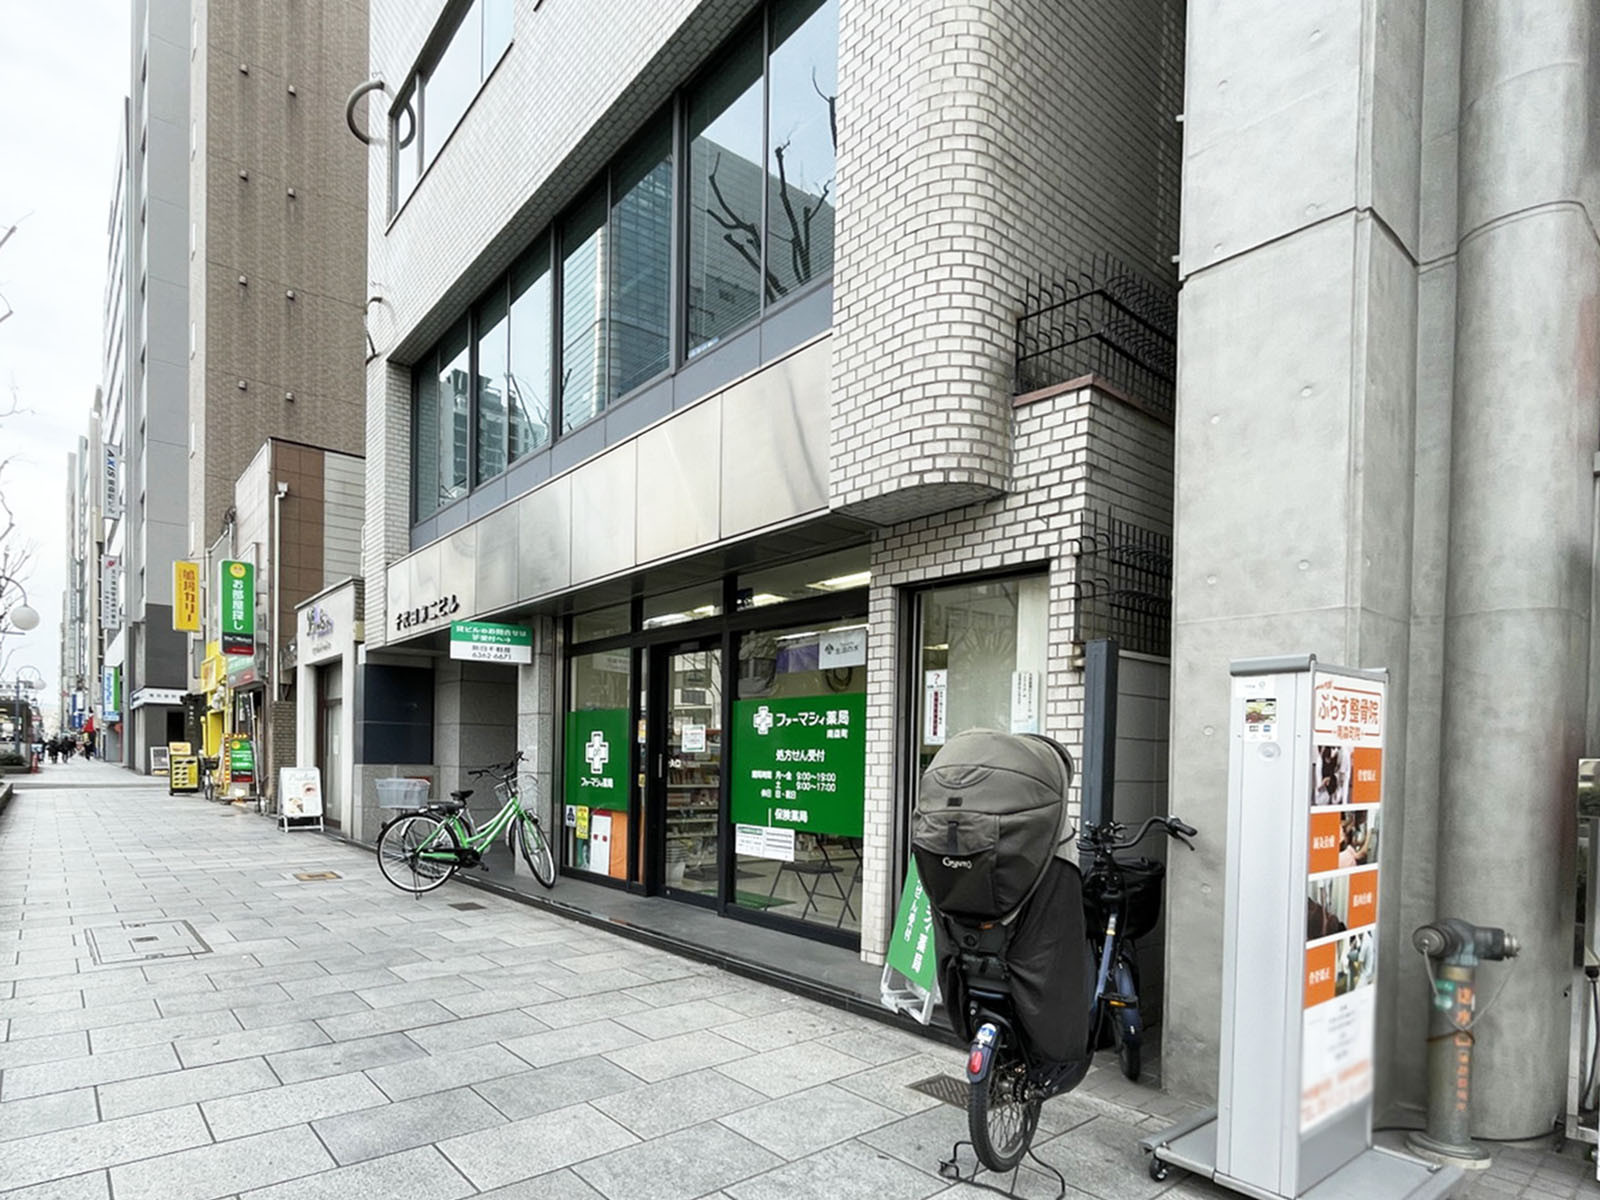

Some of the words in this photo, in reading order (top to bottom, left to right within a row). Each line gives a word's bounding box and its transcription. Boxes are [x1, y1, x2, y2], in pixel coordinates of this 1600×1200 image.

[776, 710, 850, 727] ファーマシィ薬局
[776, 749, 826, 762] 処方せん受付
